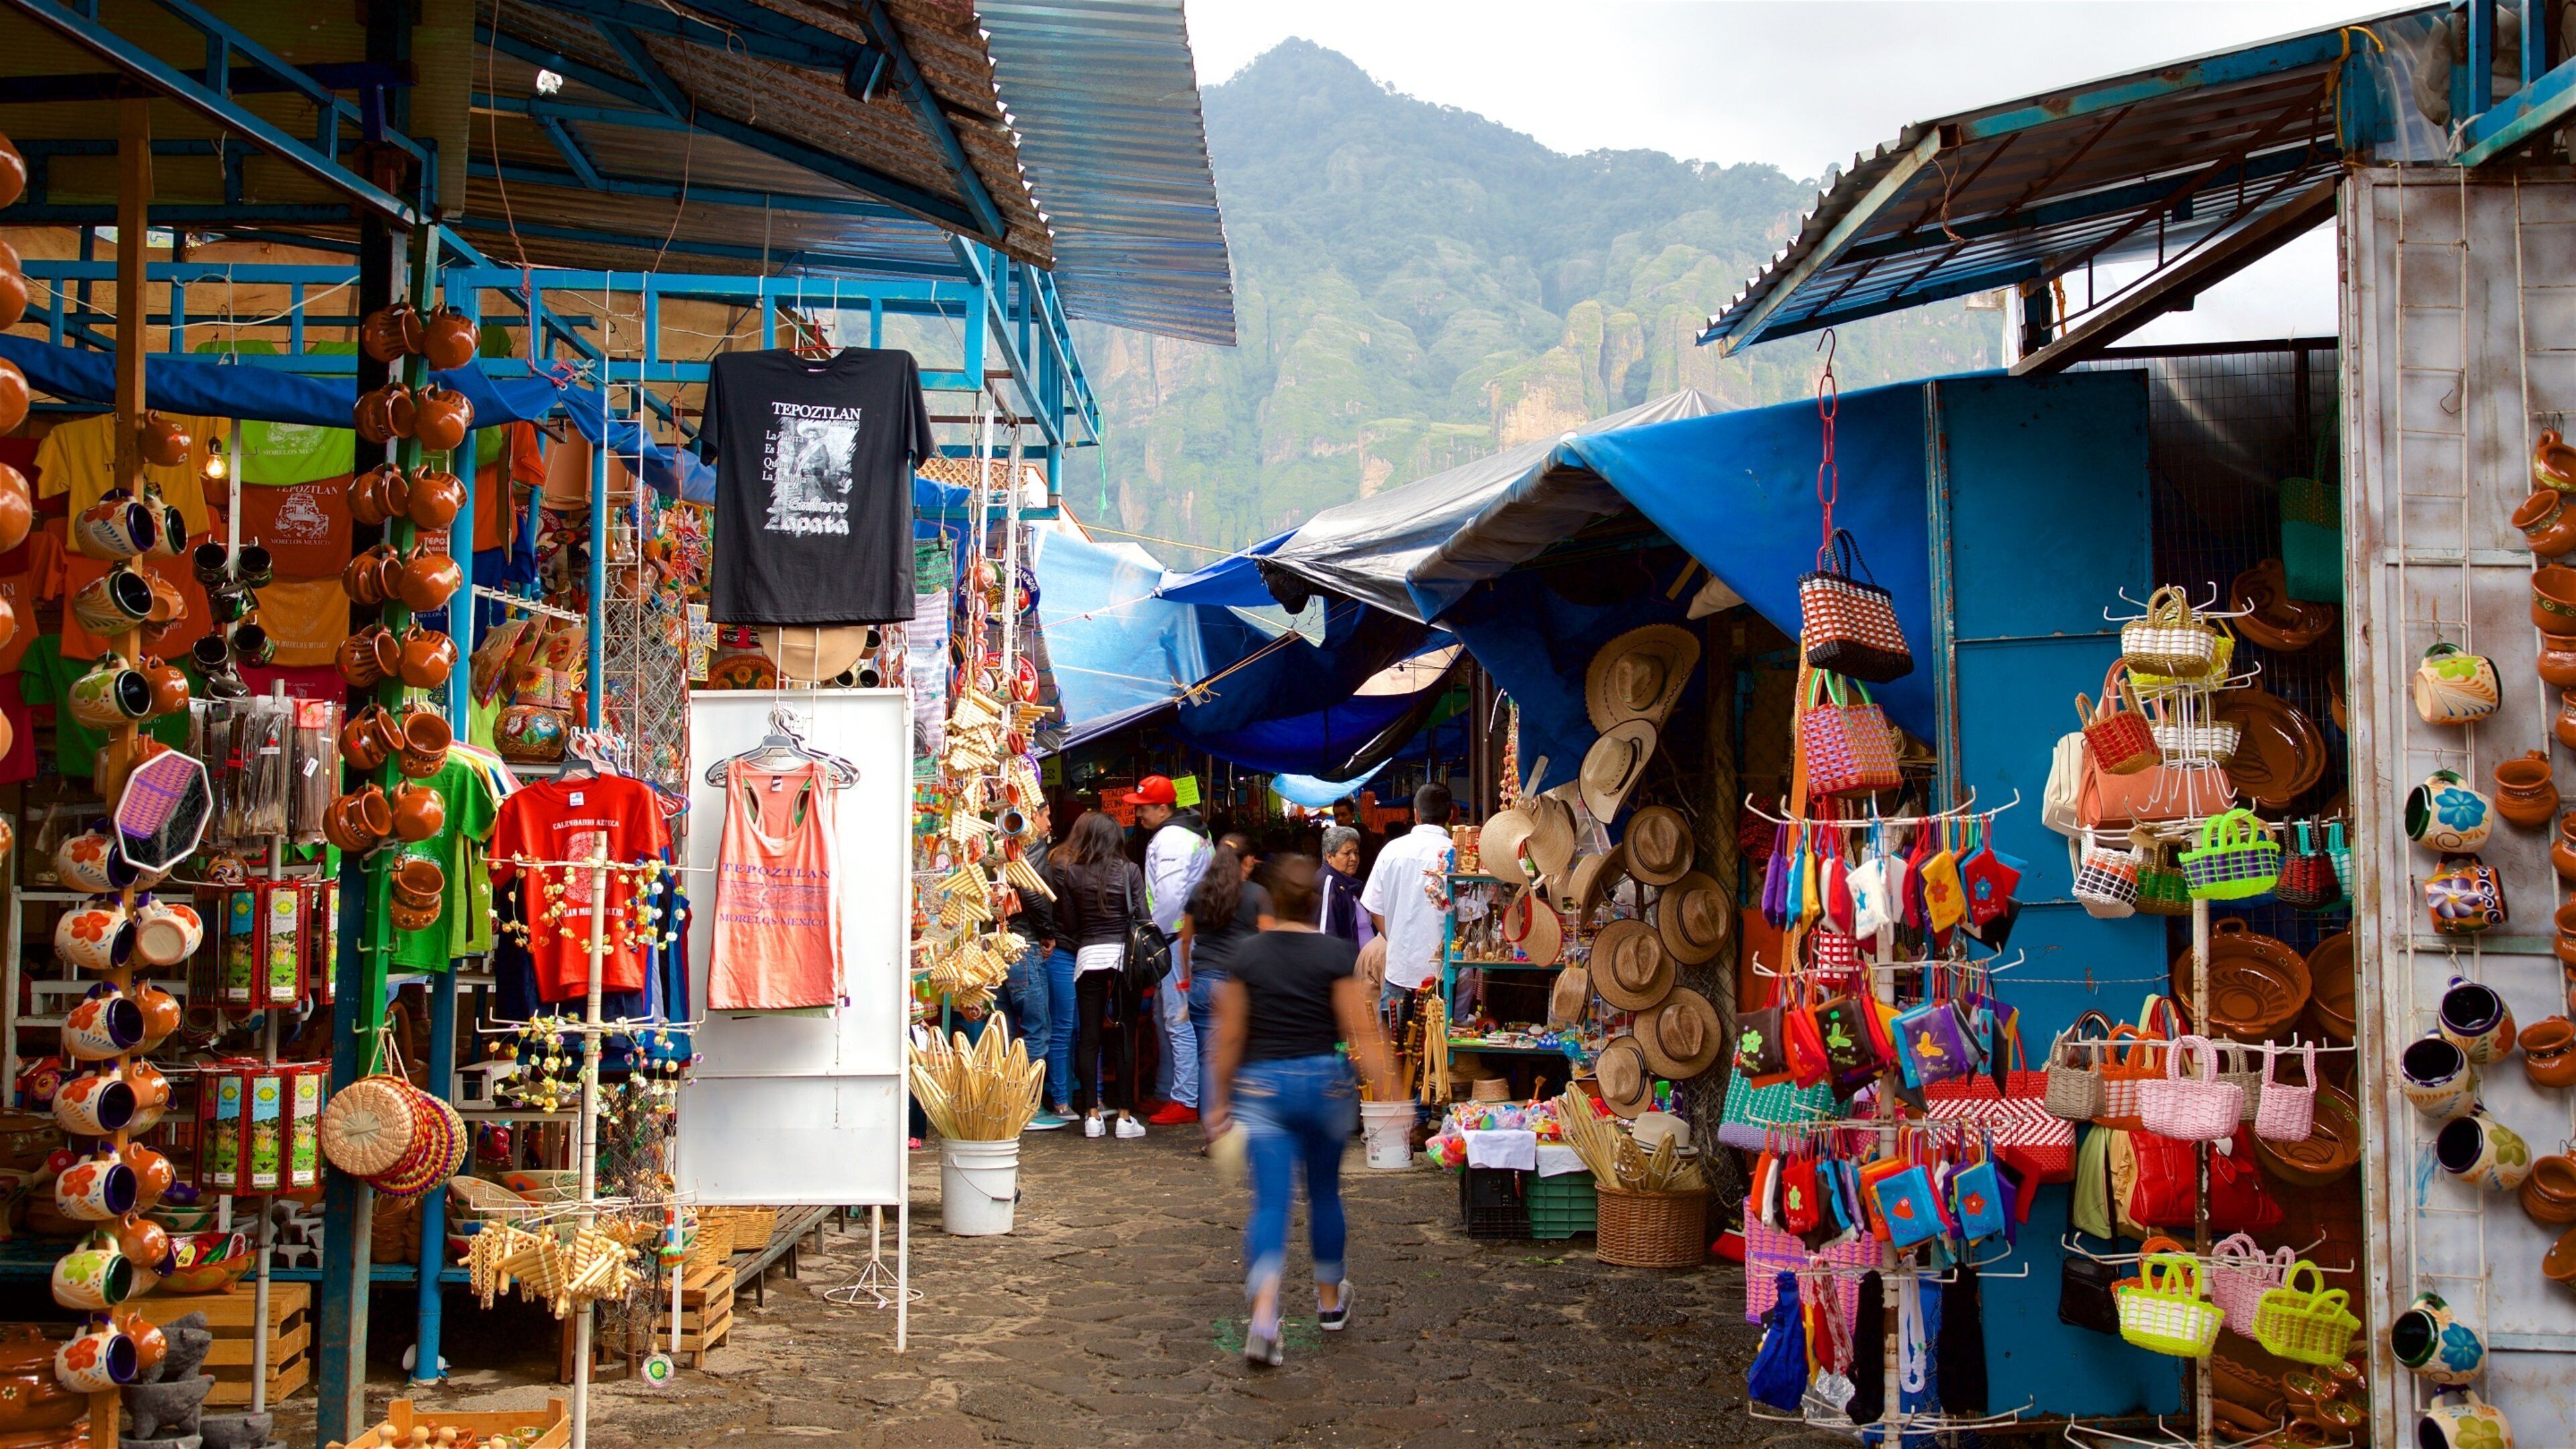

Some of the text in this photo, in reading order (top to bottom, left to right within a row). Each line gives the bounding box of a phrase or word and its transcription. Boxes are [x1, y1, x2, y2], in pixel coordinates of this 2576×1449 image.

[772, 402, 862, 420] TEPOZTLAN
[765, 430, 777, 440] La
[764, 443, 775, 454] Es
[762, 471, 773, 481] La
[276, 485, 339, 495] TEPOZTLAN
[788, 495, 849, 513] Emiliano
[764, 507, 850, 537] Zapata
[553, 819, 620, 830] CALENDARIO AZTECA
[721, 863, 830, 879] TEPOZTLAN
[719, 913, 827, 927] MORELOS MEXICO
